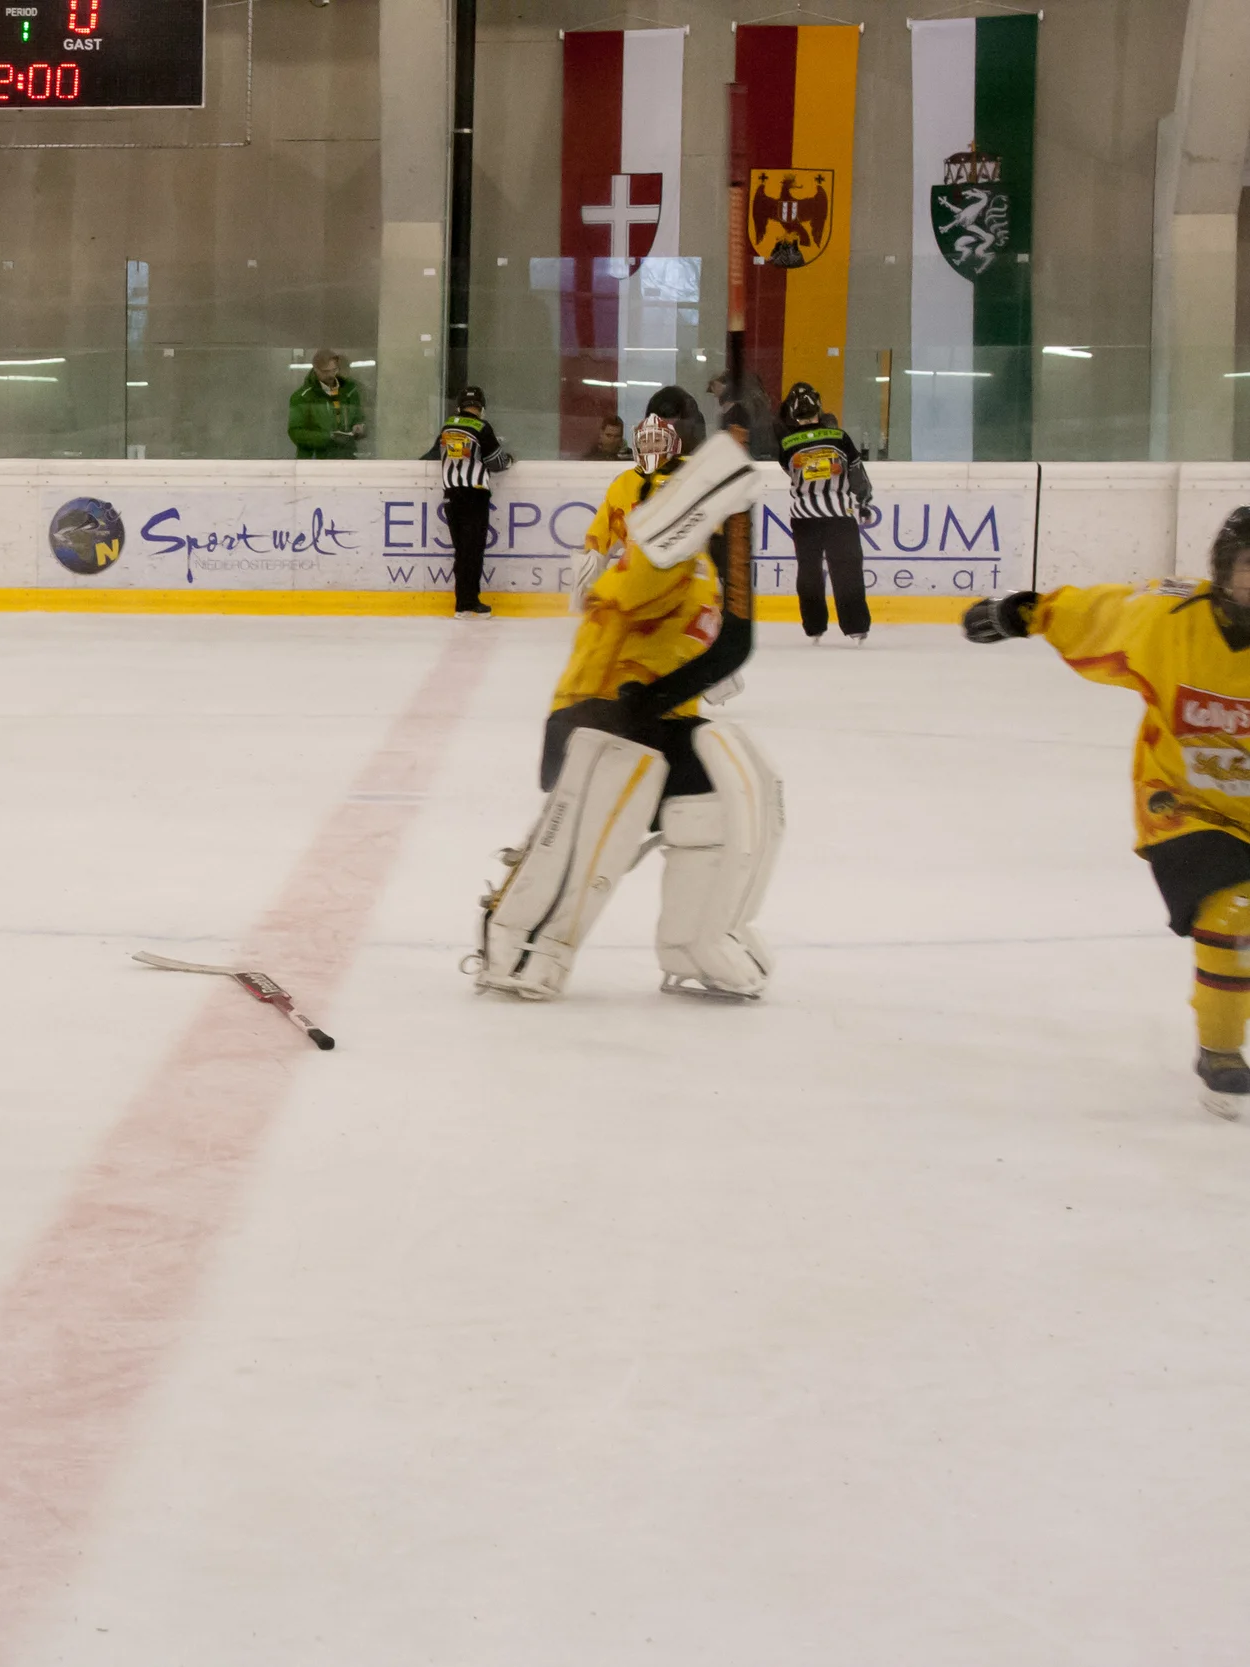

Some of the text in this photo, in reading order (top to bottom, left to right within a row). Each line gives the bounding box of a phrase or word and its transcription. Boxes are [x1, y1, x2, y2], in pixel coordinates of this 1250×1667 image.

[5, 7, 38, 17] PERIOD
[22, 21, 30, 41] 1
[63, 38, 103, 51] GAST
